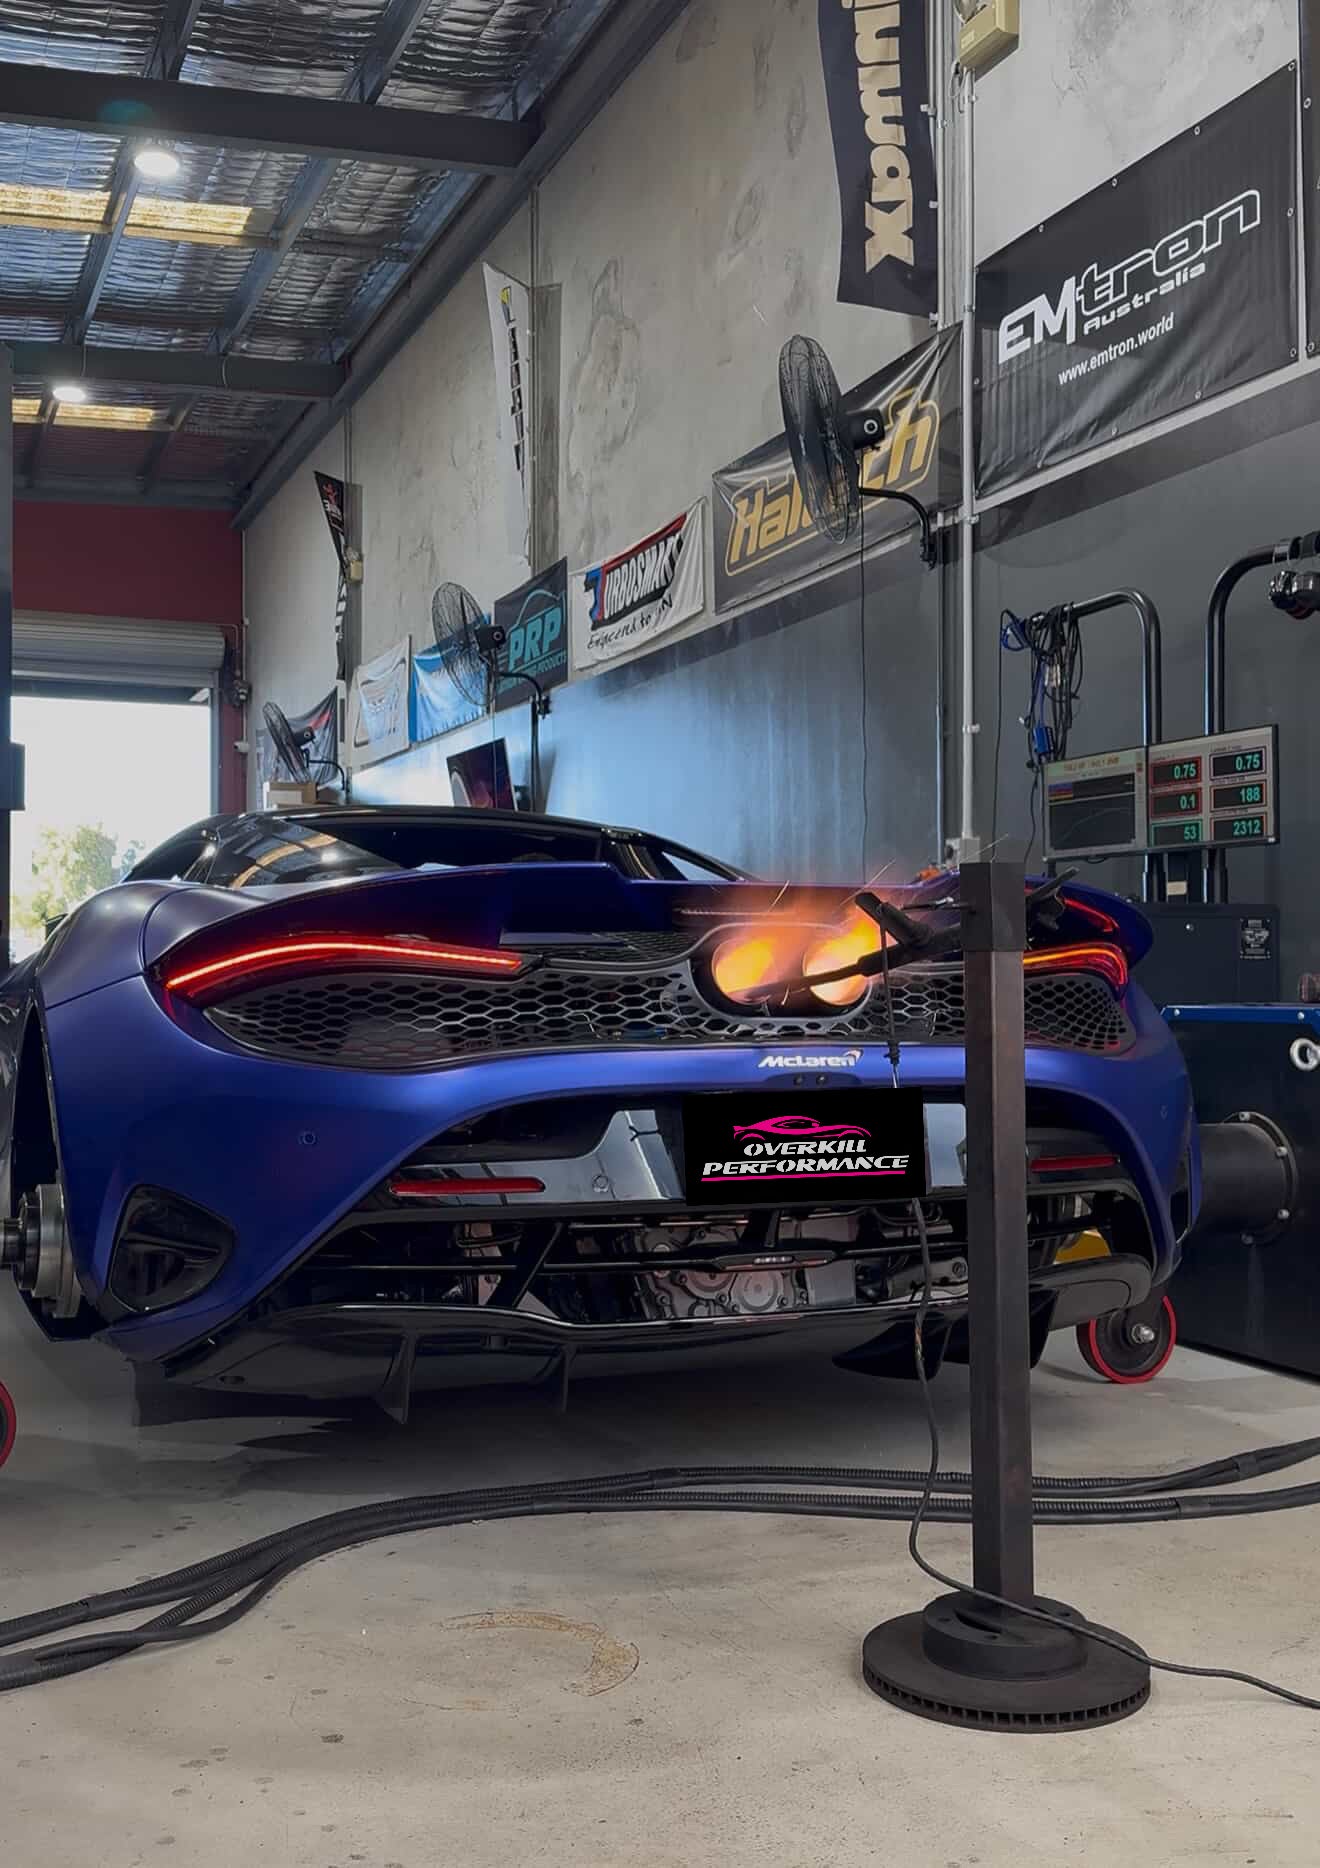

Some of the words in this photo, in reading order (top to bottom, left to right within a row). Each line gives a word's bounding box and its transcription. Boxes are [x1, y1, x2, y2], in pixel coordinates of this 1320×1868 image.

[1083, 263, 1206, 336] Australia
[1058, 312, 1174, 385] www.emtron.world
[729, 404, 933, 564] Halch
[508, 606, 562, 673] PRP
[1235, 753, 1260, 771] 0.75
[1174, 763, 1196, 780] 0.75
[1180, 794, 1196, 810] 0.1
[1240, 786, 1261, 803] 188
[1183, 825, 1197, 840] 53
[1232, 819, 1261, 836] 2312
[758, 1054, 858, 1068] McLaren
